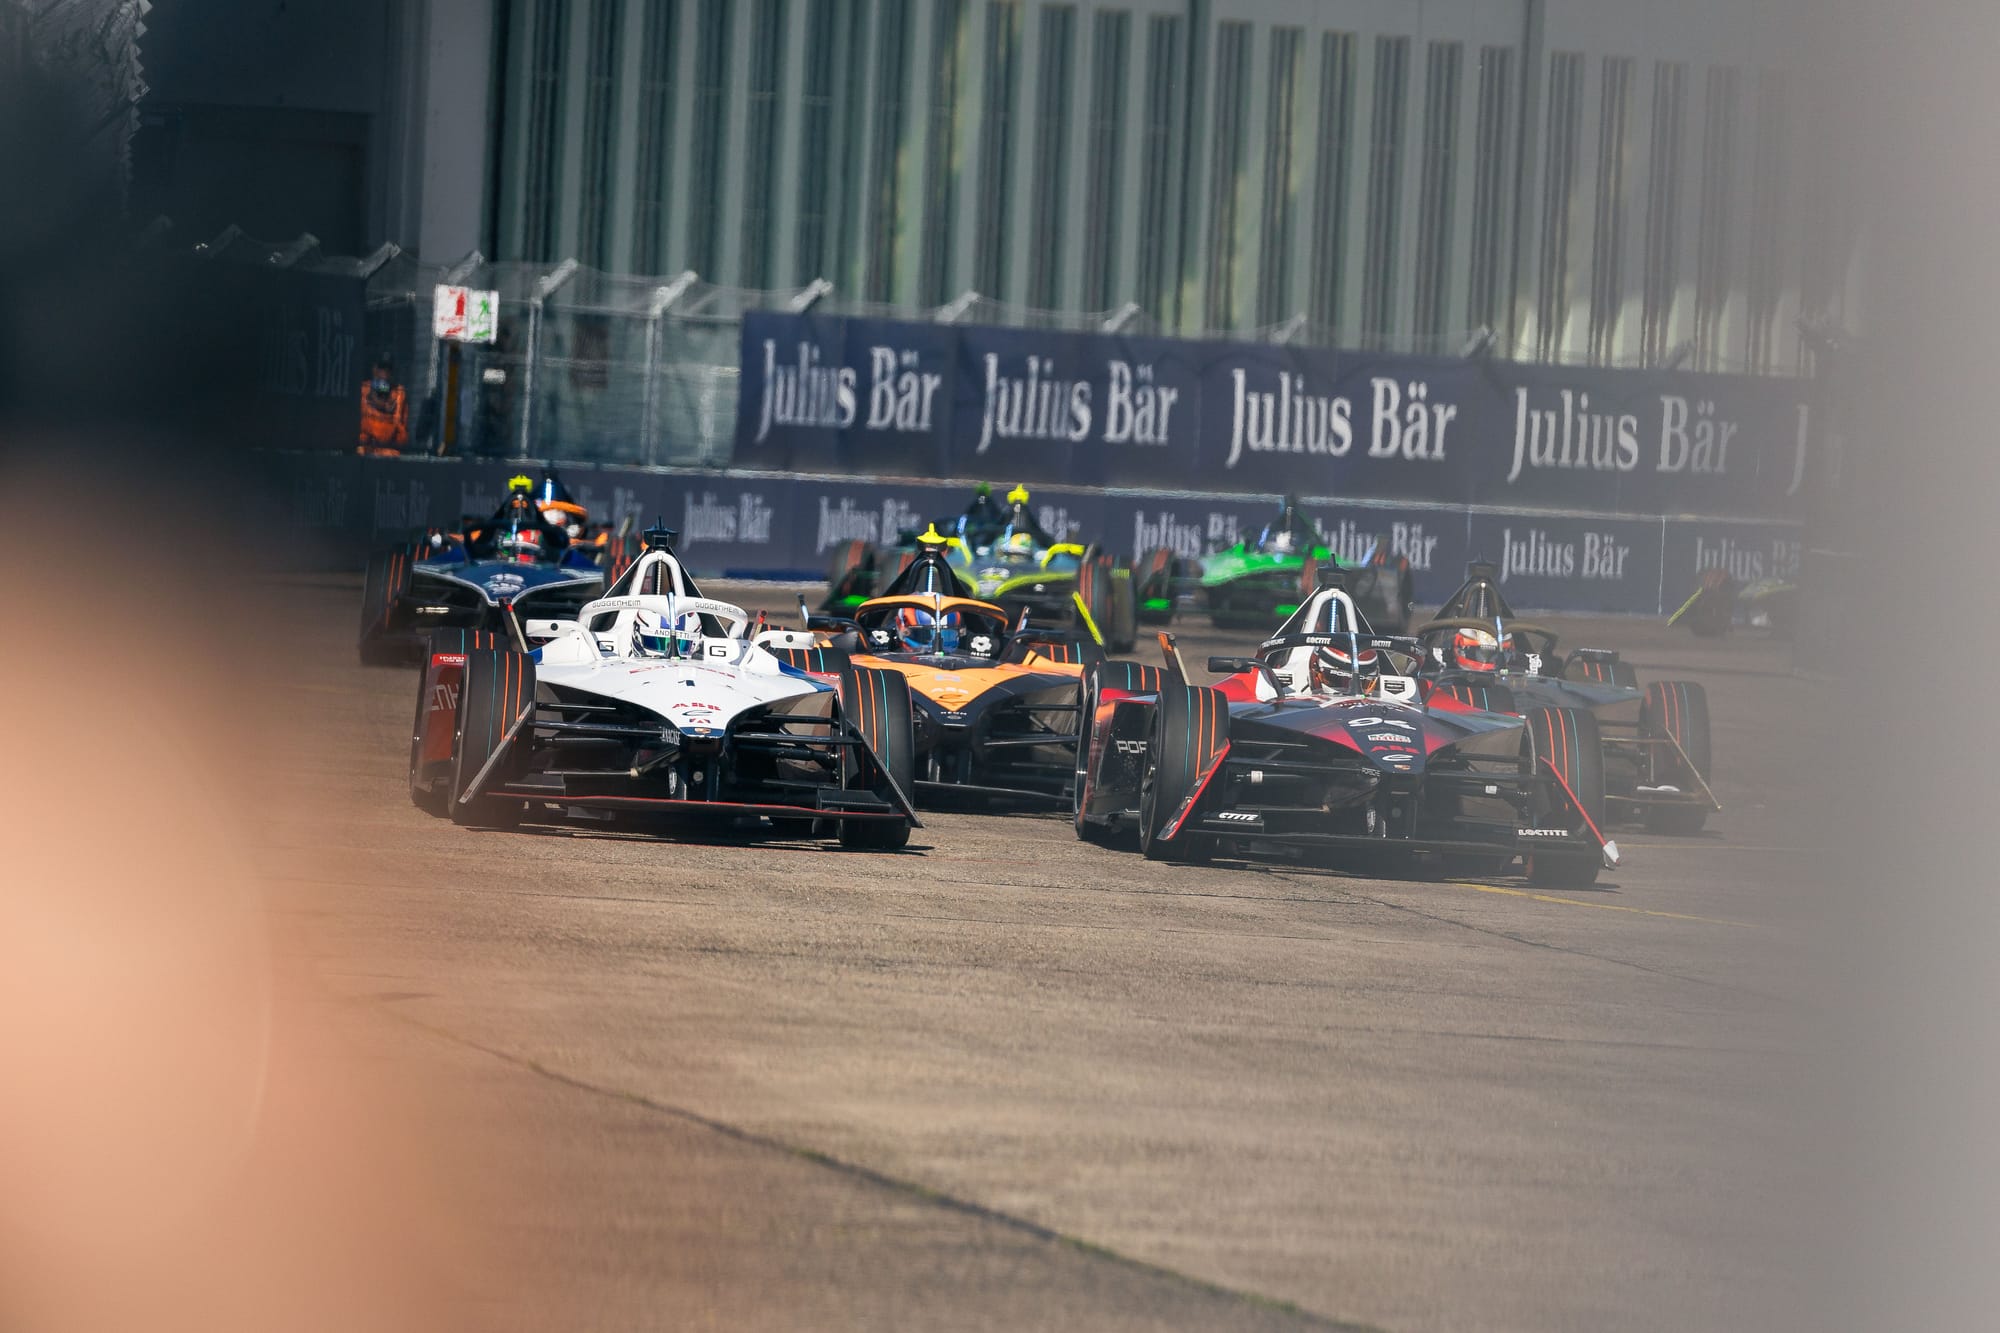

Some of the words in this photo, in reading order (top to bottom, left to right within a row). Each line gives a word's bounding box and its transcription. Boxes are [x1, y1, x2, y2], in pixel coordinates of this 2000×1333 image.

[754, 338, 857, 443] Julius
[866, 346, 942, 432] Bär
[976, 352, 1091, 454] Julius
[1104, 359, 1178, 446] Bär
[1225, 368, 1352, 469] Julius
[1368, 377, 1457, 461] Bär
[1507, 386, 1638, 484] Julius
[1656, 394, 1737, 473] Bär
[682, 491, 736, 551] Julius
[738, 492, 773, 543] Bär
[1501, 528, 1574, 584] Julius
[1581, 532, 1629, 579] Bär
[592, 600, 641, 609] GUGGENHEIM
[709, 645, 727, 658] G
[1306, 637, 1331, 645] LOCTITE
[1371, 640, 1391, 648] LOCTITE
